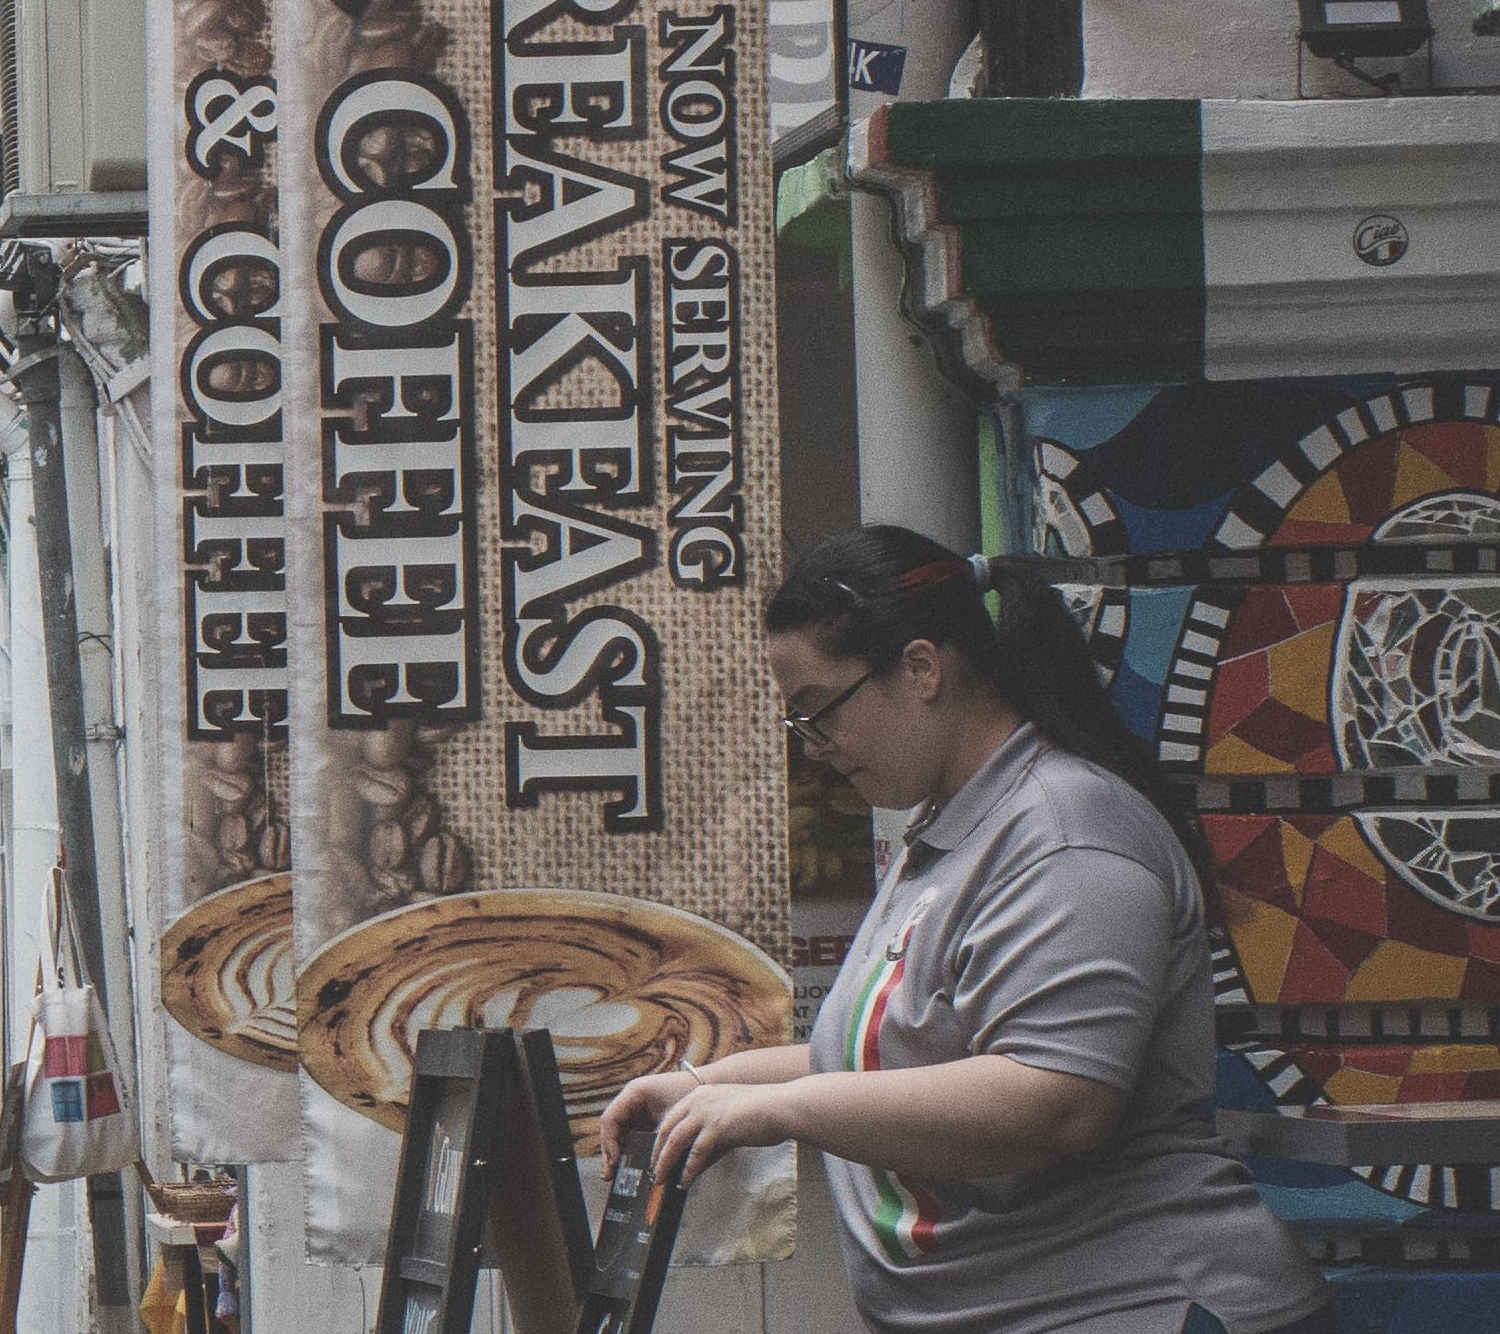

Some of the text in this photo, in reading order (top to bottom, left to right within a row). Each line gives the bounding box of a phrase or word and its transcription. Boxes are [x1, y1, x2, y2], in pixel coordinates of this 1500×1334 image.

[183, 223, 290, 741] COFFEE
[315, 72, 477, 728] COFFEE
[661, 8, 741, 587] NOW SERVING
